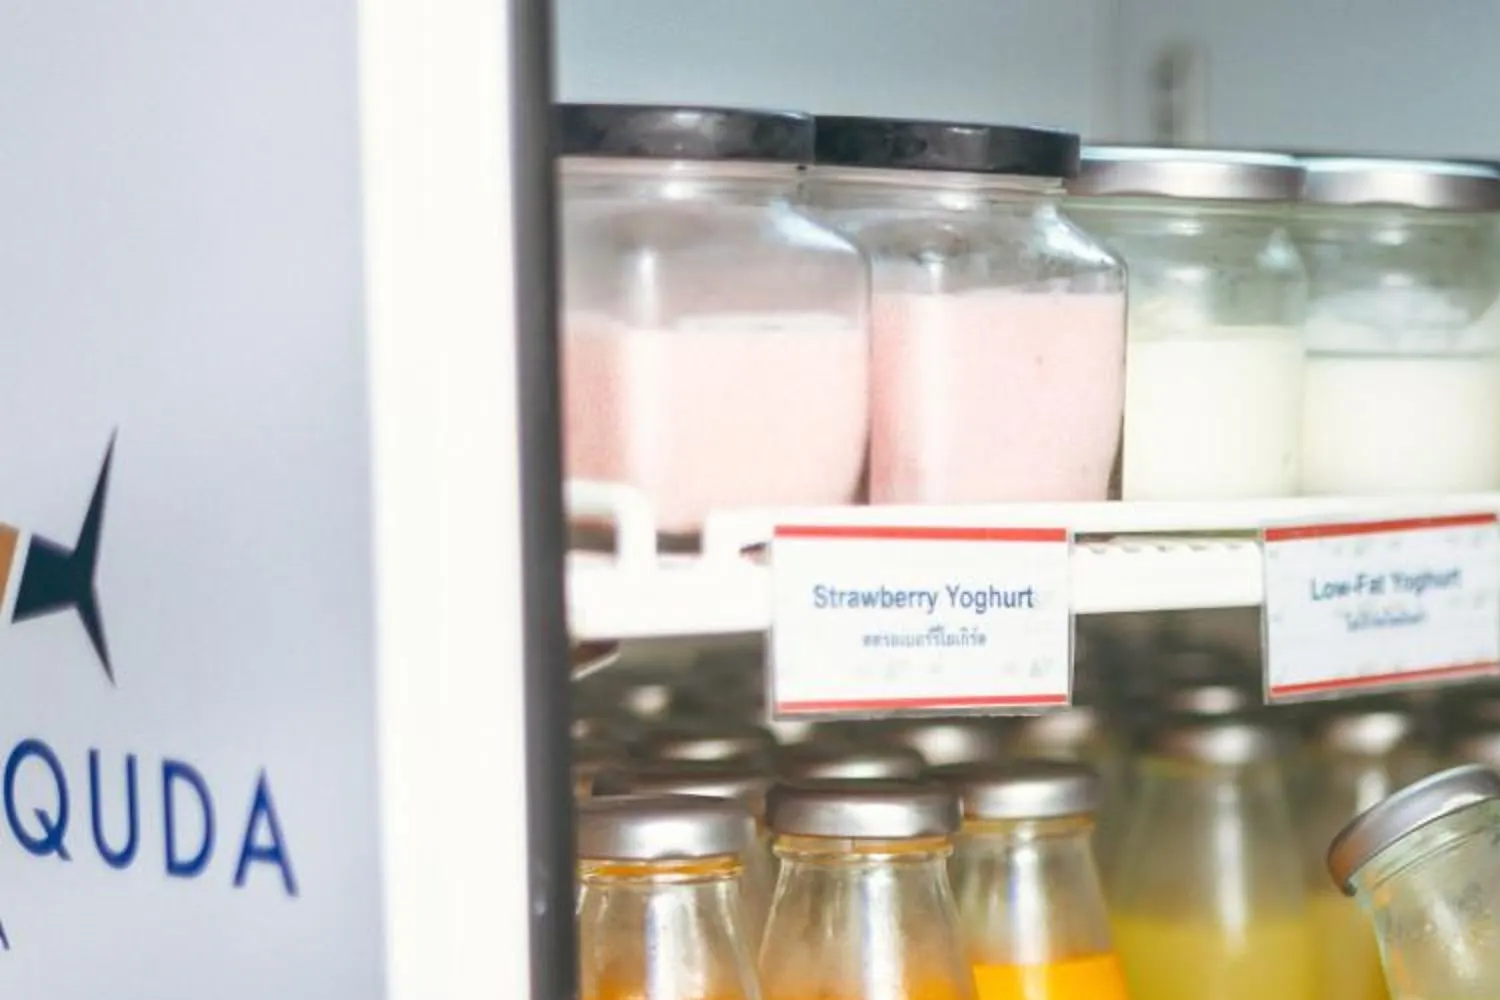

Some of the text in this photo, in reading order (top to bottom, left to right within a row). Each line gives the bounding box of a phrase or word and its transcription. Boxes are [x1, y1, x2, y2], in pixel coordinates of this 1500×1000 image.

[1389, 567, 1463, 597] Yoghurt
[812, 583, 1034, 615] Strawberry Yoghurt
[3, 737, 299, 898] QUDA
